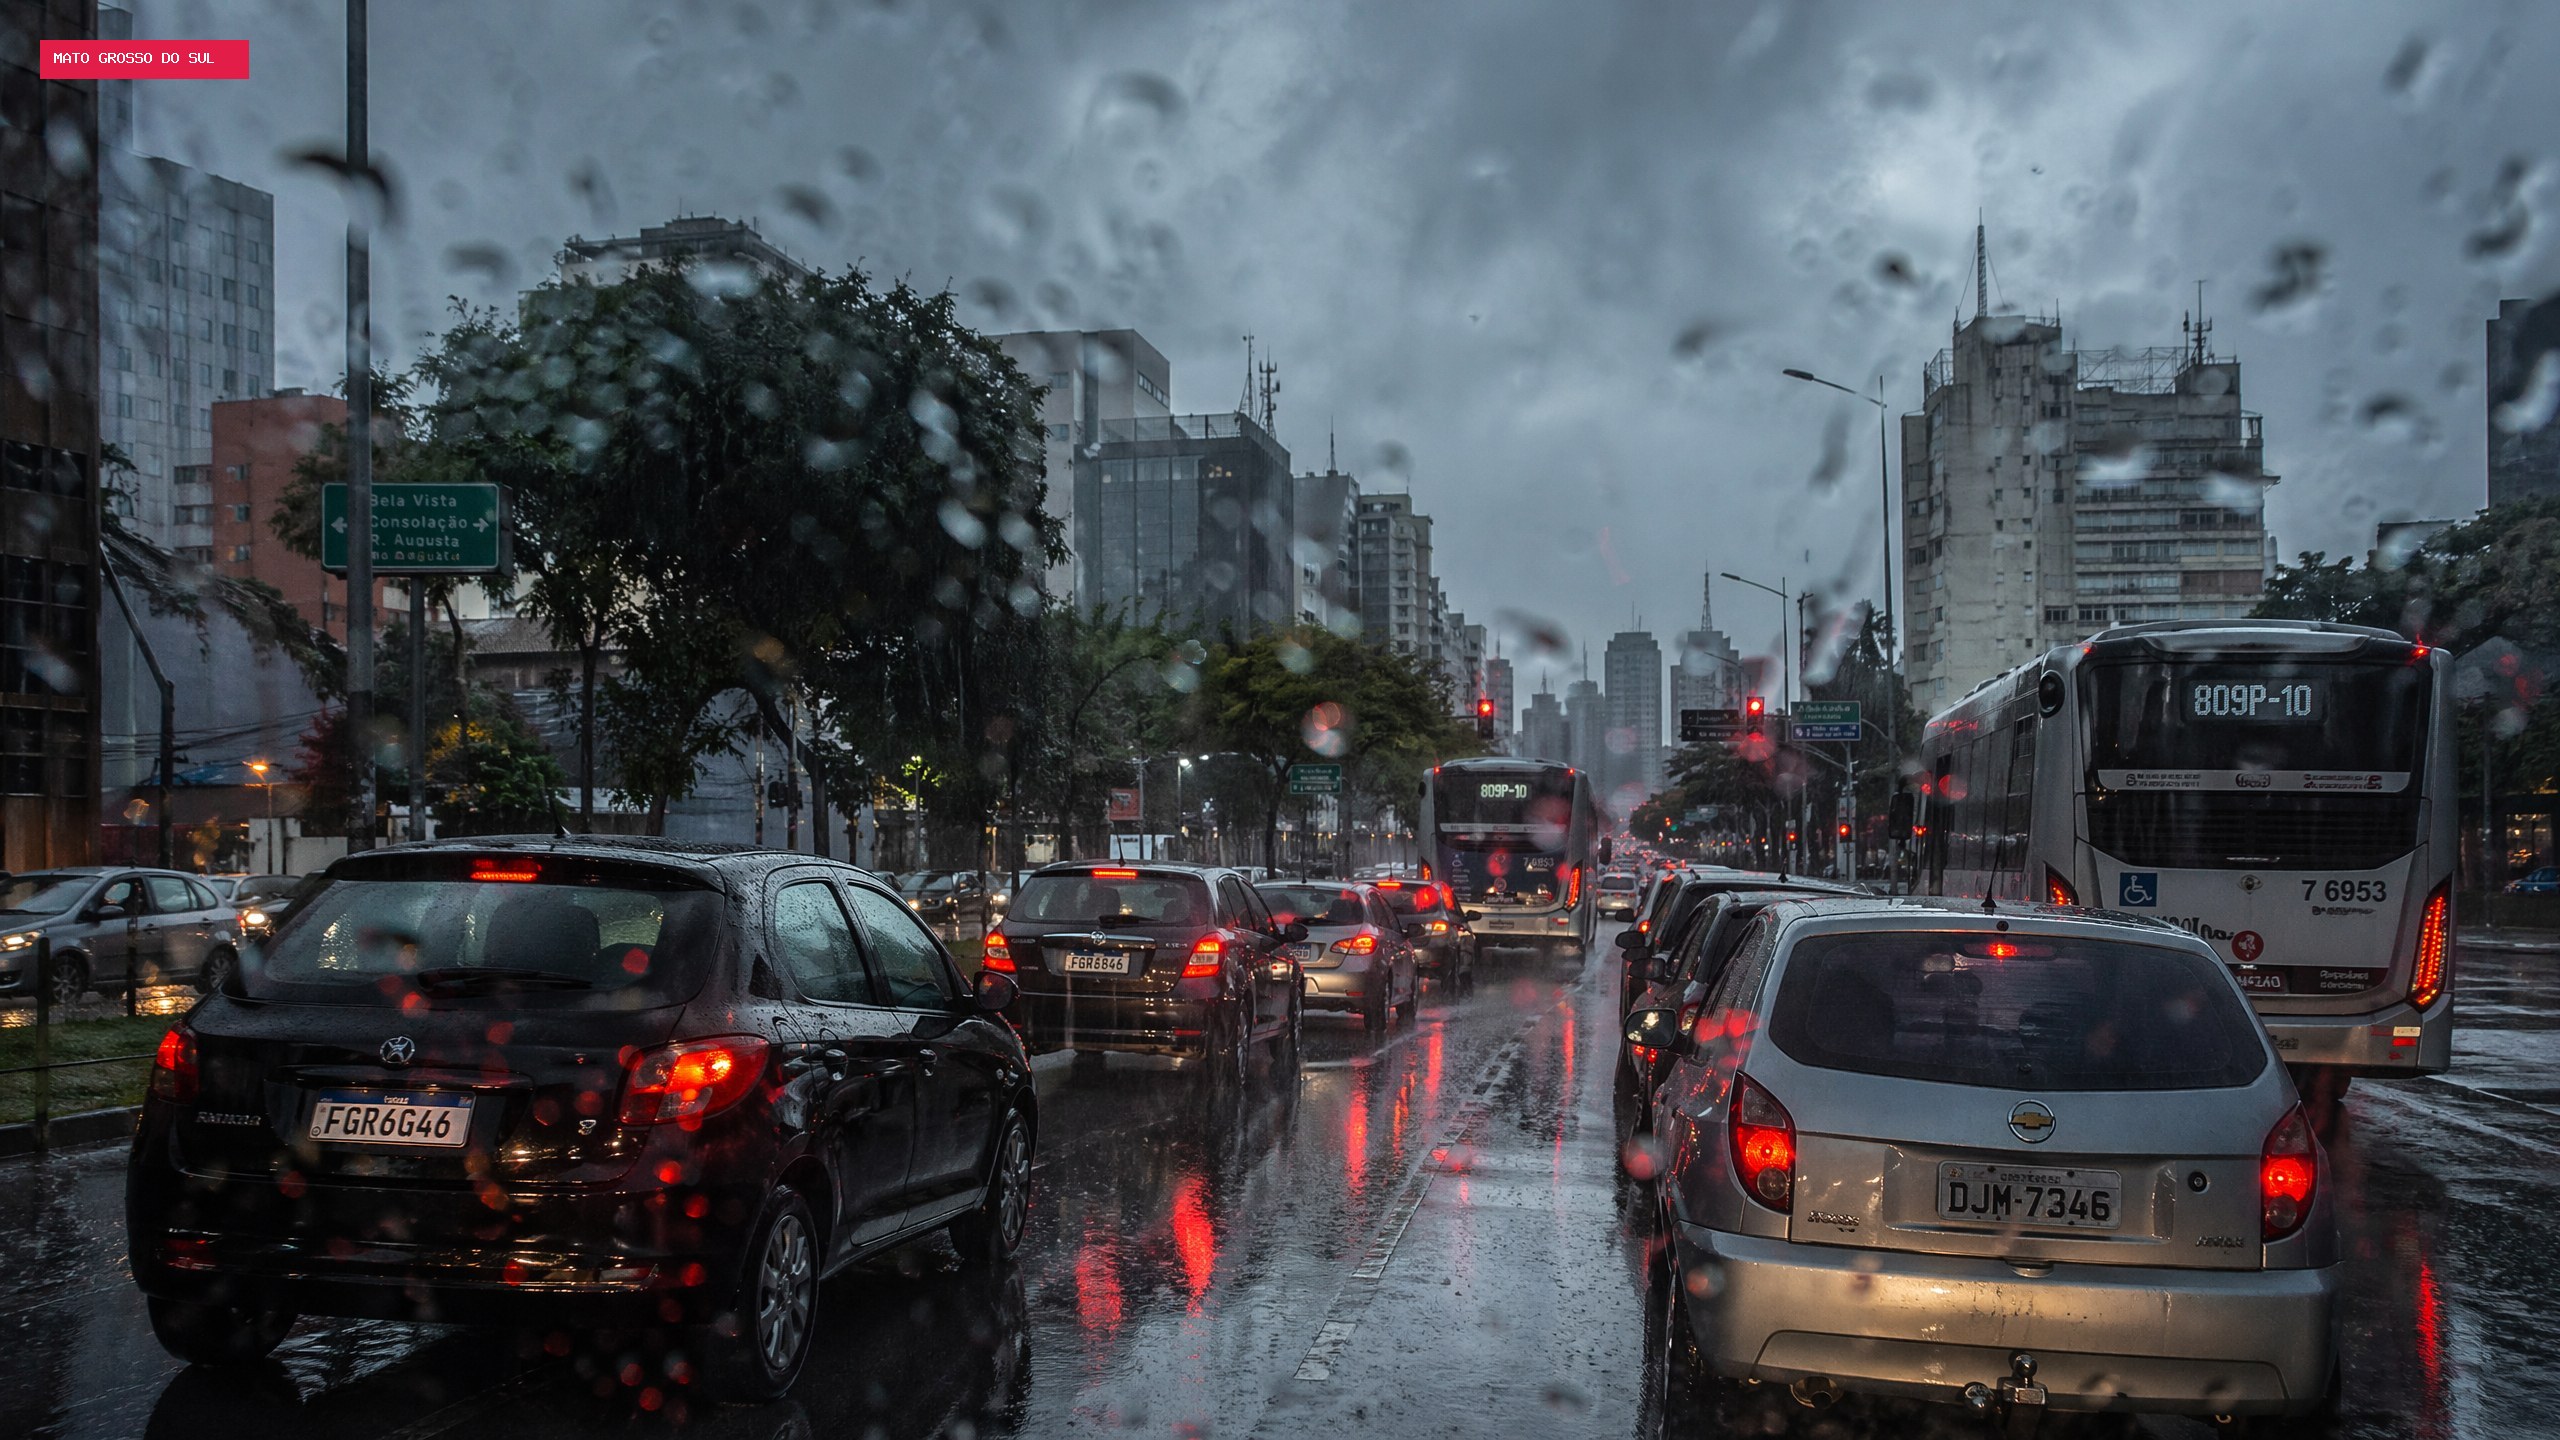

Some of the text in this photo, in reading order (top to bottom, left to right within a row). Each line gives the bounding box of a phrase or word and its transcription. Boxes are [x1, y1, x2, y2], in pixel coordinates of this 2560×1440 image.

[370, 494, 457, 507] Bela Vista
[2194, 684, 2312, 716] 809P-10
[1480, 784, 1527, 799] 809P-10
[2301, 879, 2387, 902] 7 6953
[323, 1106, 451, 1139] FGR6G46
[1948, 1181, 2111, 1221] DJM-7346
